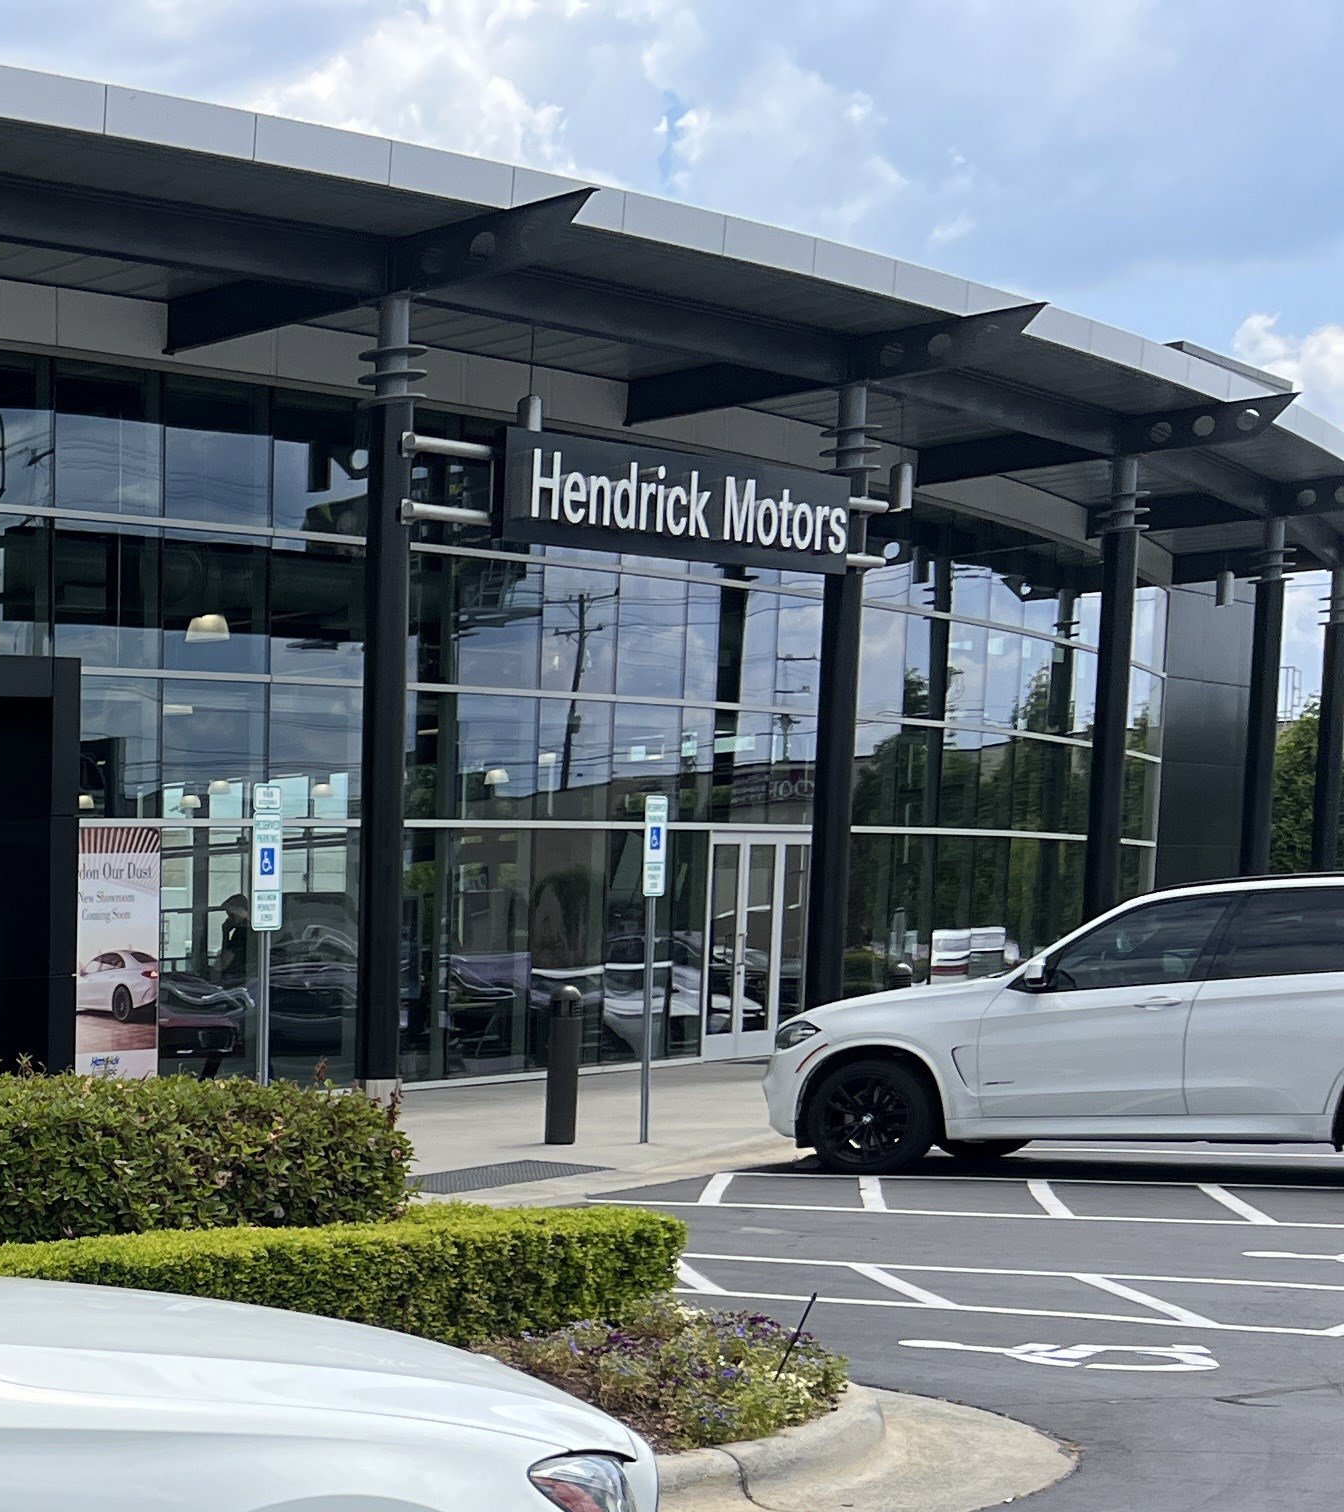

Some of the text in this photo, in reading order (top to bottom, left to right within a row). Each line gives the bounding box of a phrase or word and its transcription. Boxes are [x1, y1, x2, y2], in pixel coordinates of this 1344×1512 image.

[529, 447, 848, 555] Hendrick Motors
[78, 862, 152, 880] don Our Dust
[81, 907, 131, 924] Coming Soon
